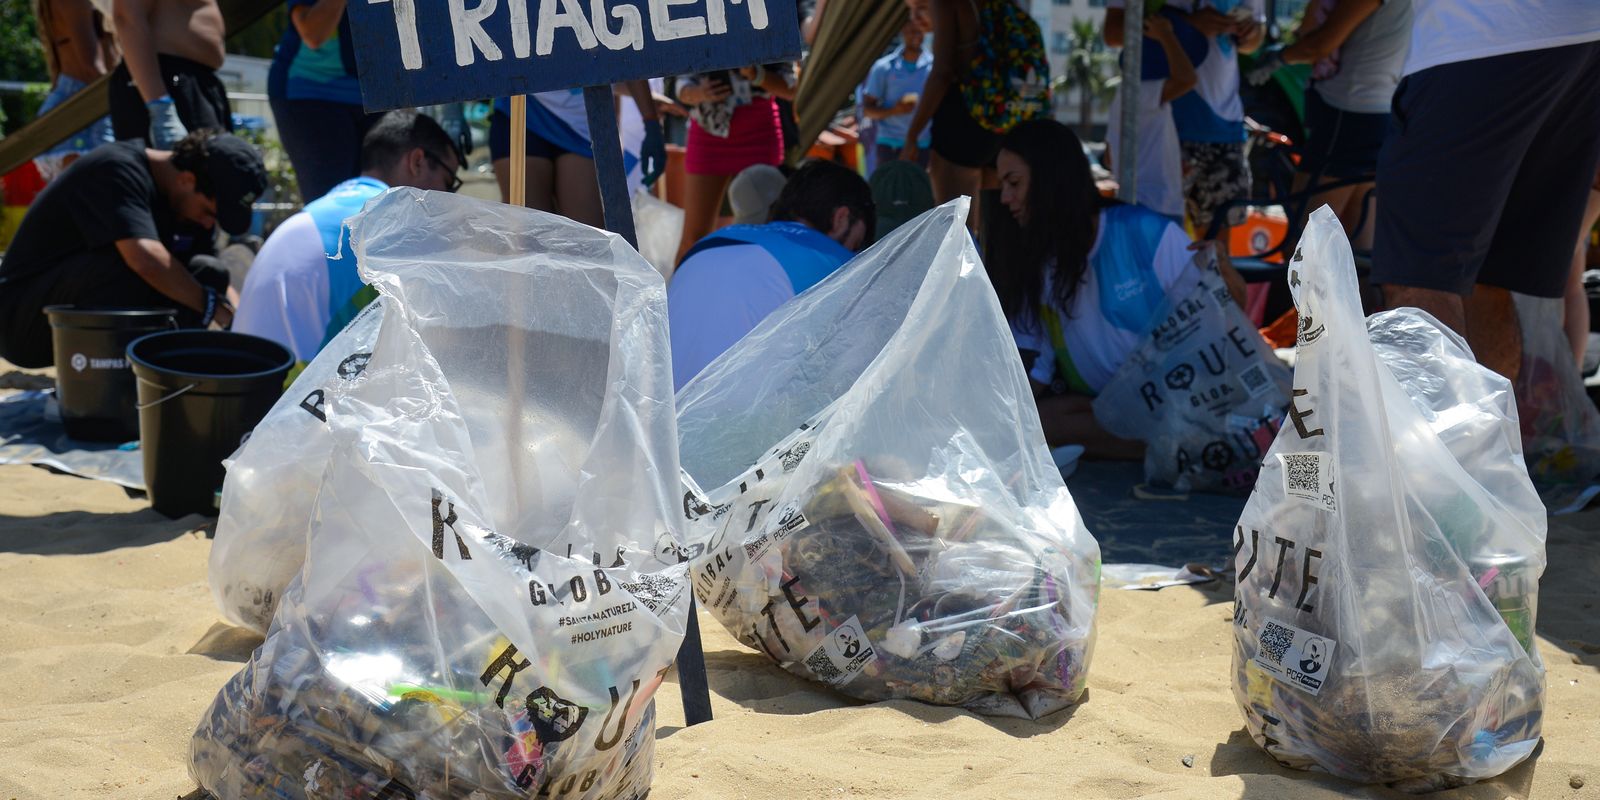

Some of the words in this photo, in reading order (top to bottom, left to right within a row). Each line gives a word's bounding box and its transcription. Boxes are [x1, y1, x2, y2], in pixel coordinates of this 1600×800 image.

[367, 0, 770, 70] TRIAGEM
[696, 546, 733, 605] GLOBAL
[571, 621, 632, 645] #HOLYNATURE
